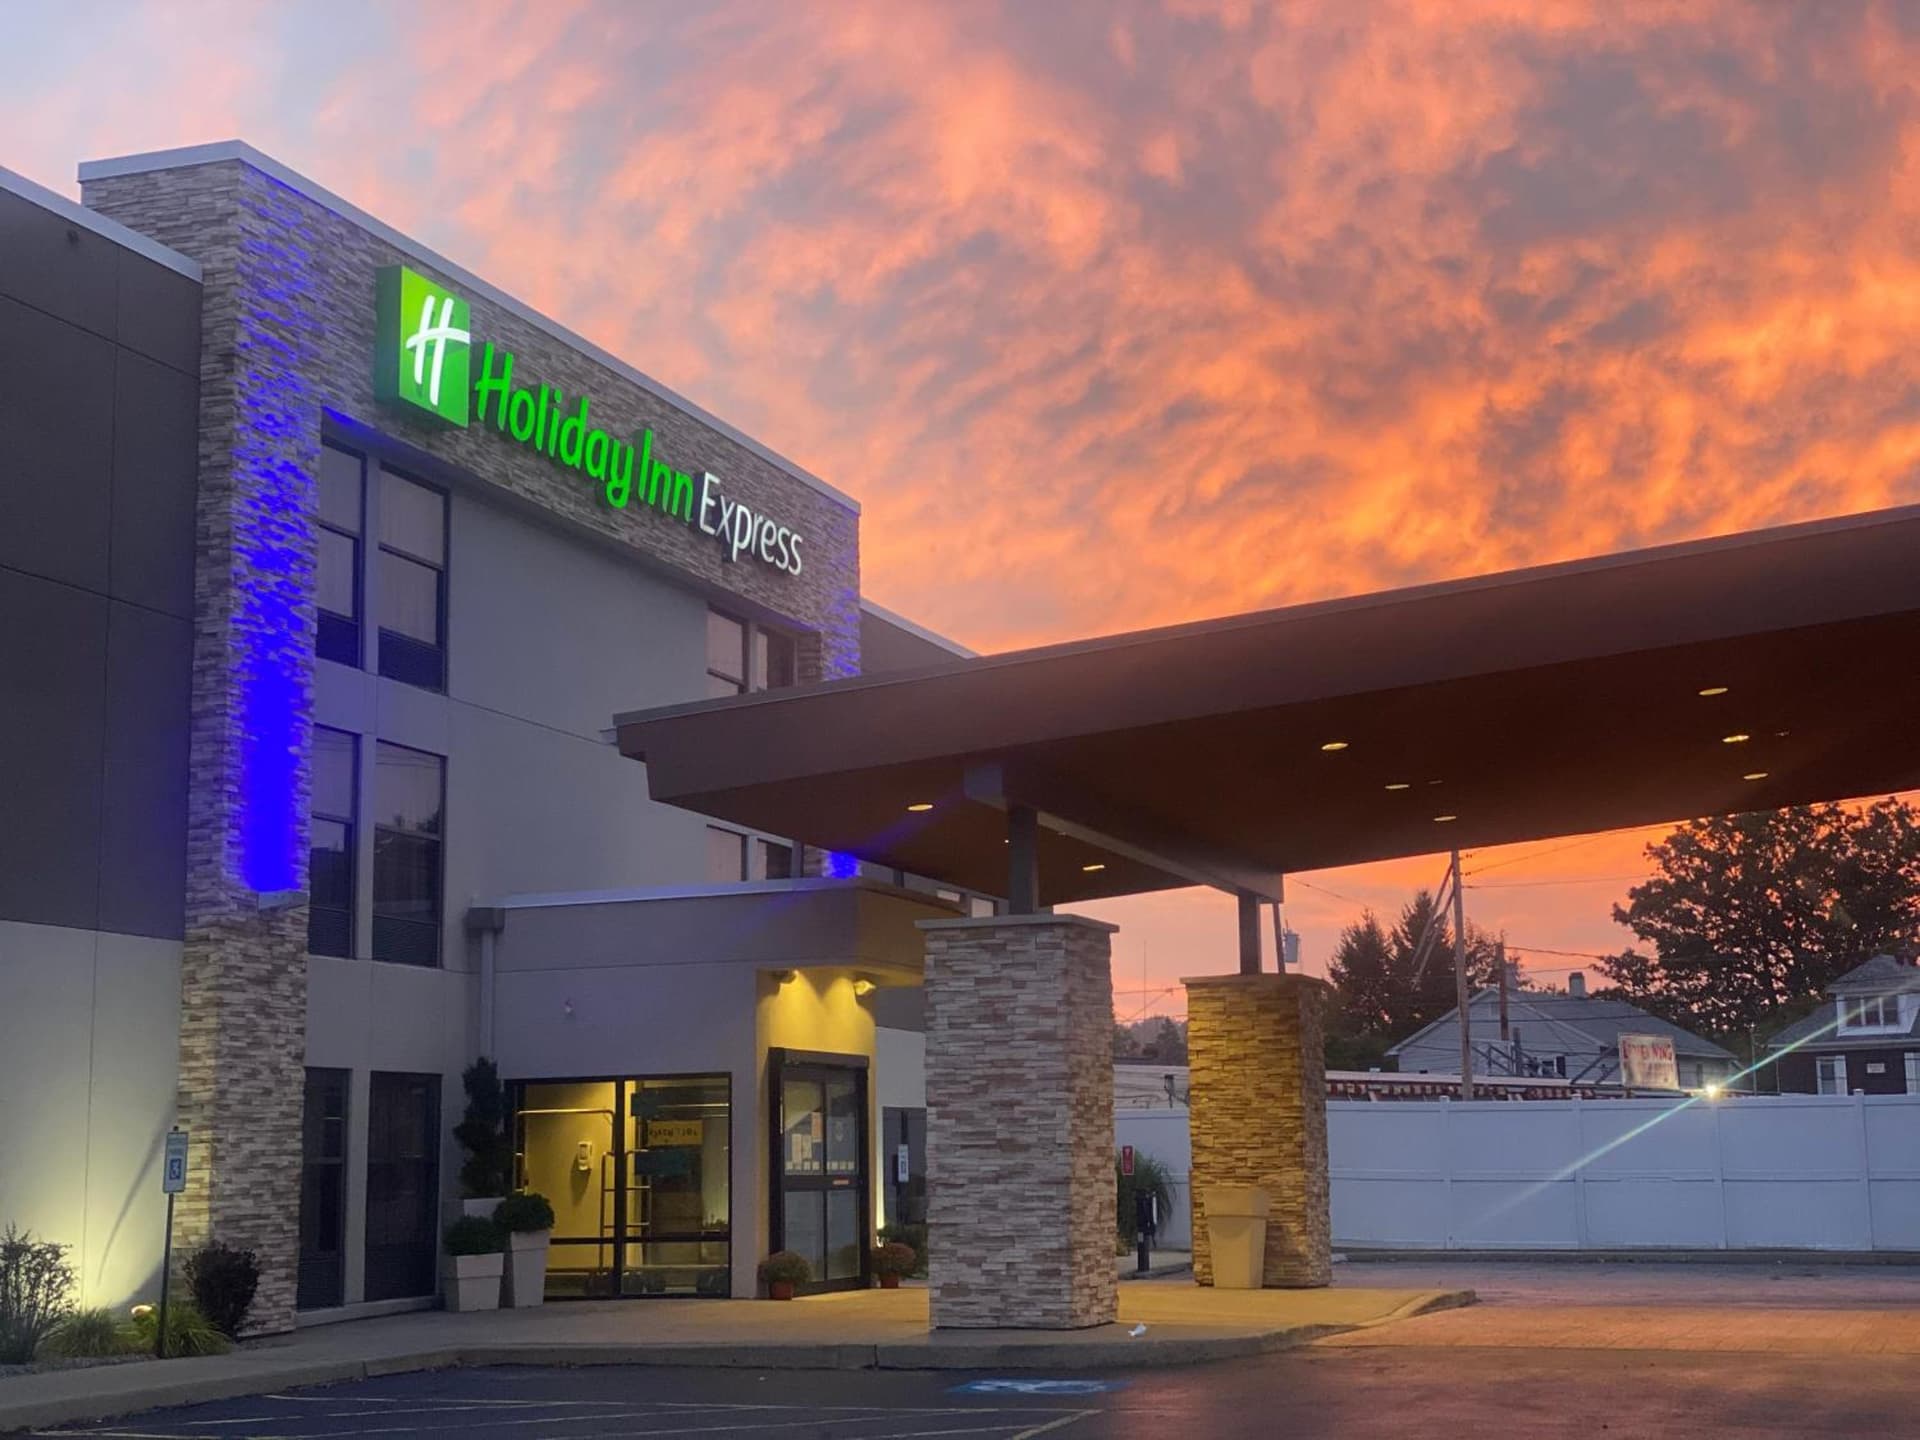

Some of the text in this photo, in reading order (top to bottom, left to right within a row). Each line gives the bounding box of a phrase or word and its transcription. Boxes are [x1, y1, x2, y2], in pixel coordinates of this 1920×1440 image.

[474, 342, 804, 576] Holiday Inn Express
